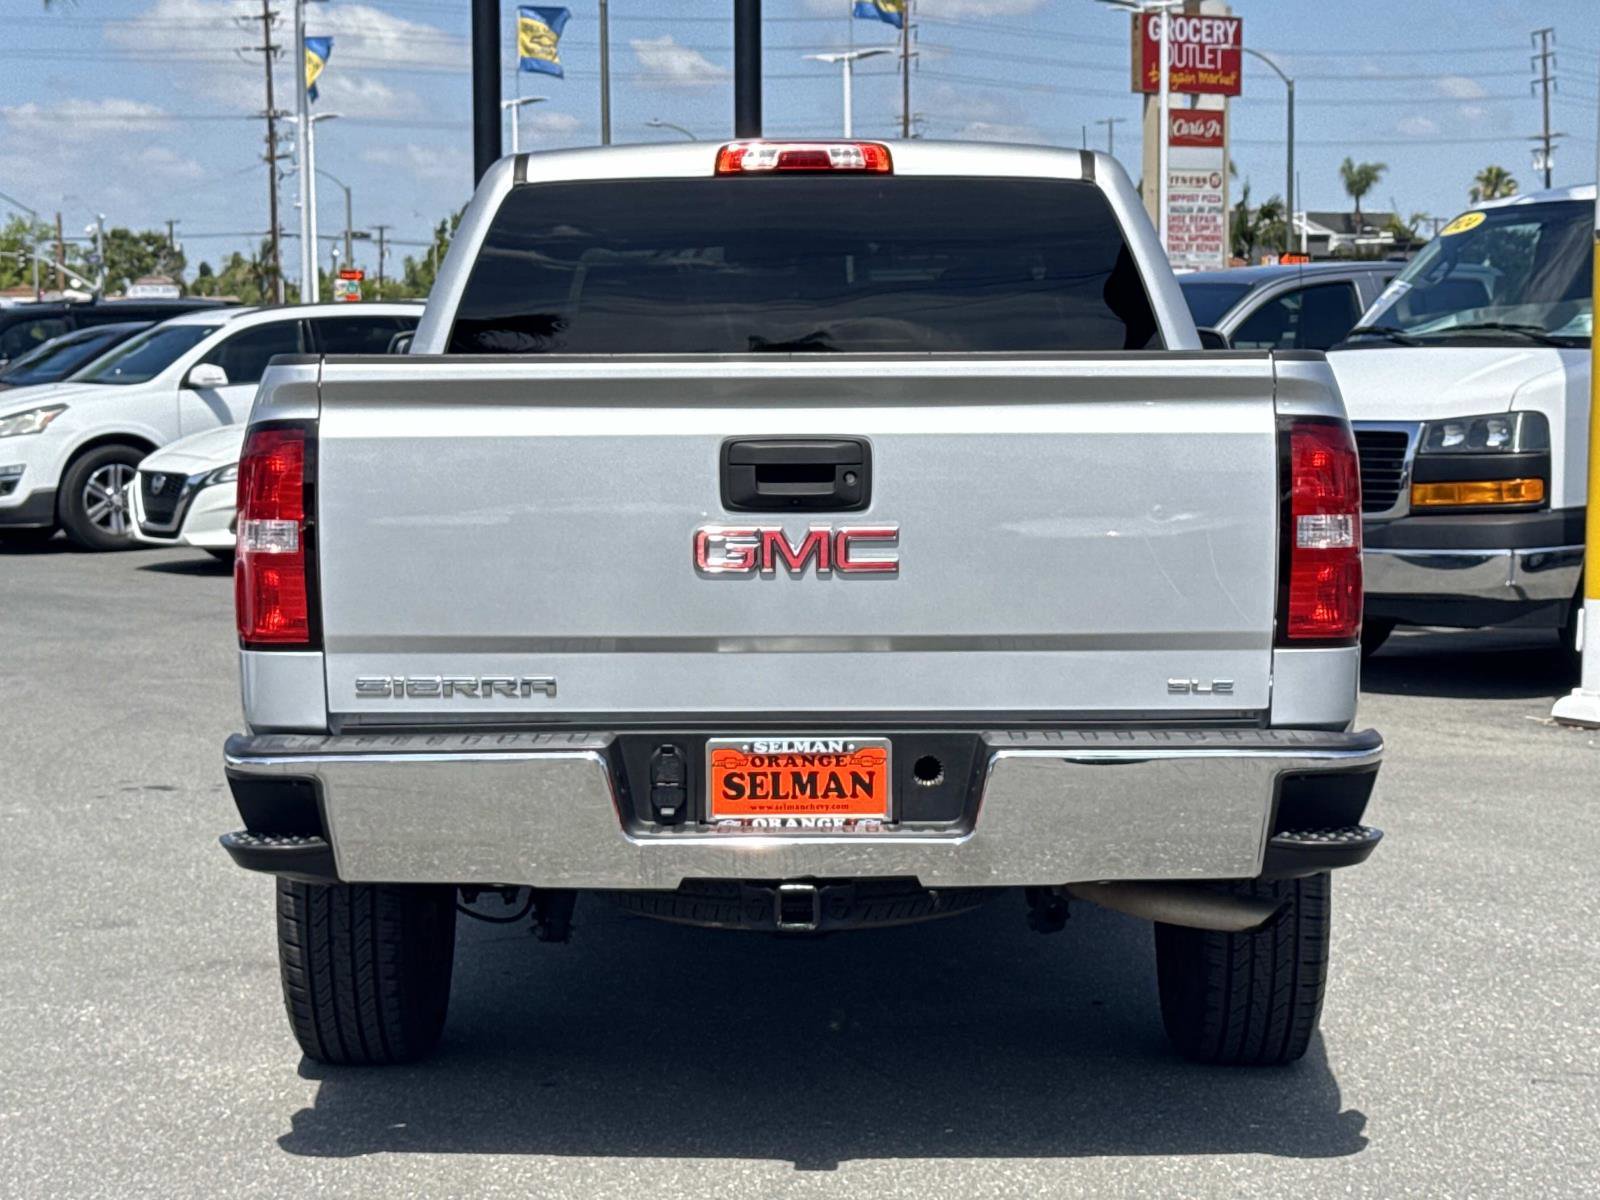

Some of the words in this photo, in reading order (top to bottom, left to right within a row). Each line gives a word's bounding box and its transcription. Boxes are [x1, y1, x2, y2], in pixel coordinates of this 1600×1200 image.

[693, 525, 900, 574] GMC
[355, 676, 558, 698] SIERRA
[1168, 679, 1234, 695] SLE
[753, 741, 844, 753] SELMAN
[750, 755, 848, 768] ORANGE
[722, 771, 876, 800] SELMAN
[752, 818, 846, 828] ORANGE
